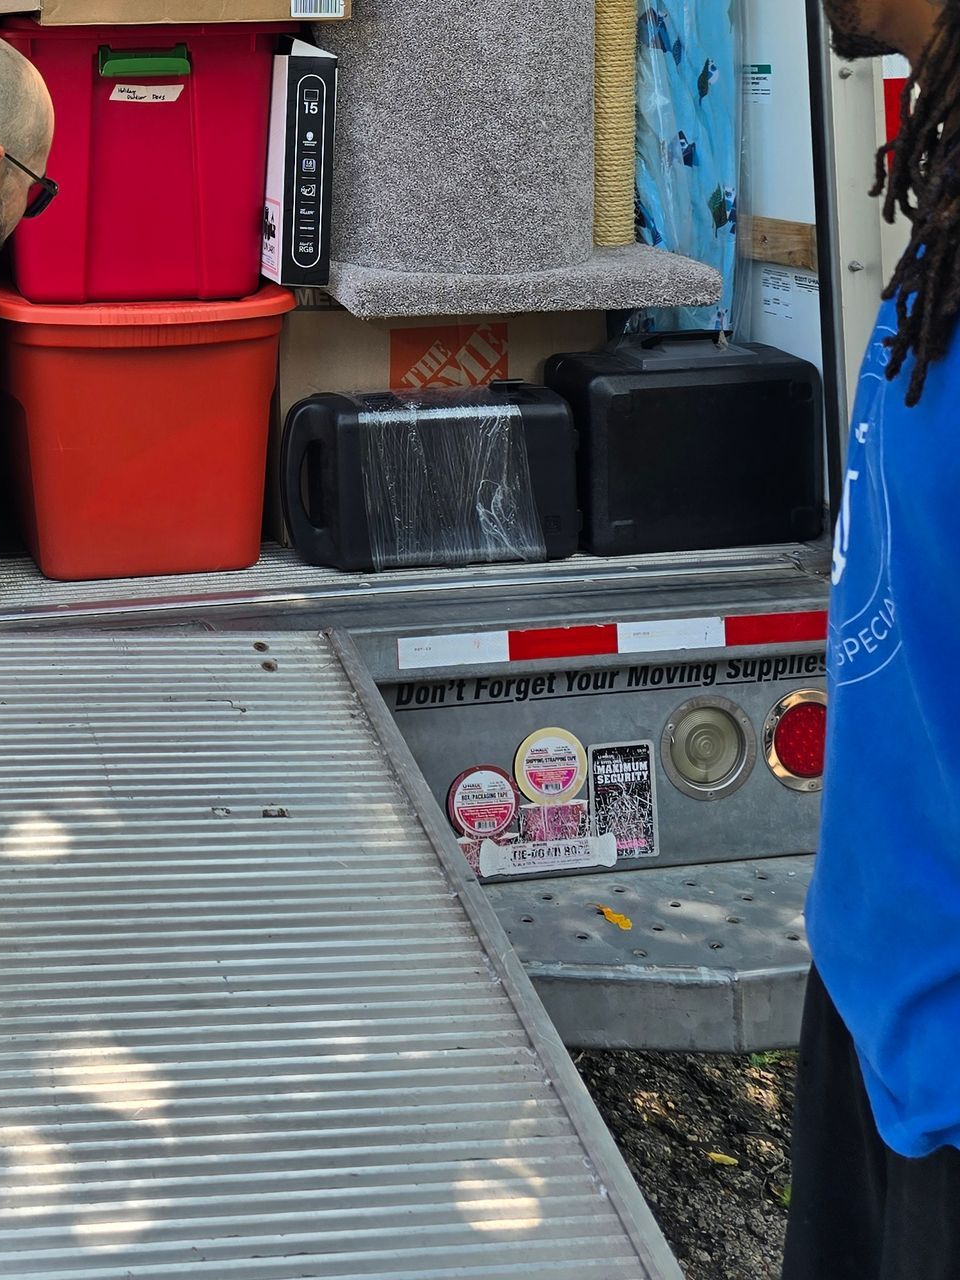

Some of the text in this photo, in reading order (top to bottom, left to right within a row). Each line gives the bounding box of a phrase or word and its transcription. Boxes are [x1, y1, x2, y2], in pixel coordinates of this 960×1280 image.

[303, 101, 318, 114] 15
[400, 339, 453, 388] THE
[396, 678, 466, 706] Don't
[474, 672, 557, 702] Forget
[566, 670, 619, 692] Your
[627, 662, 717, 687] Moving
[597, 761, 648, 774] MAXIMUM
[597, 771, 649, 785] SECURITY
